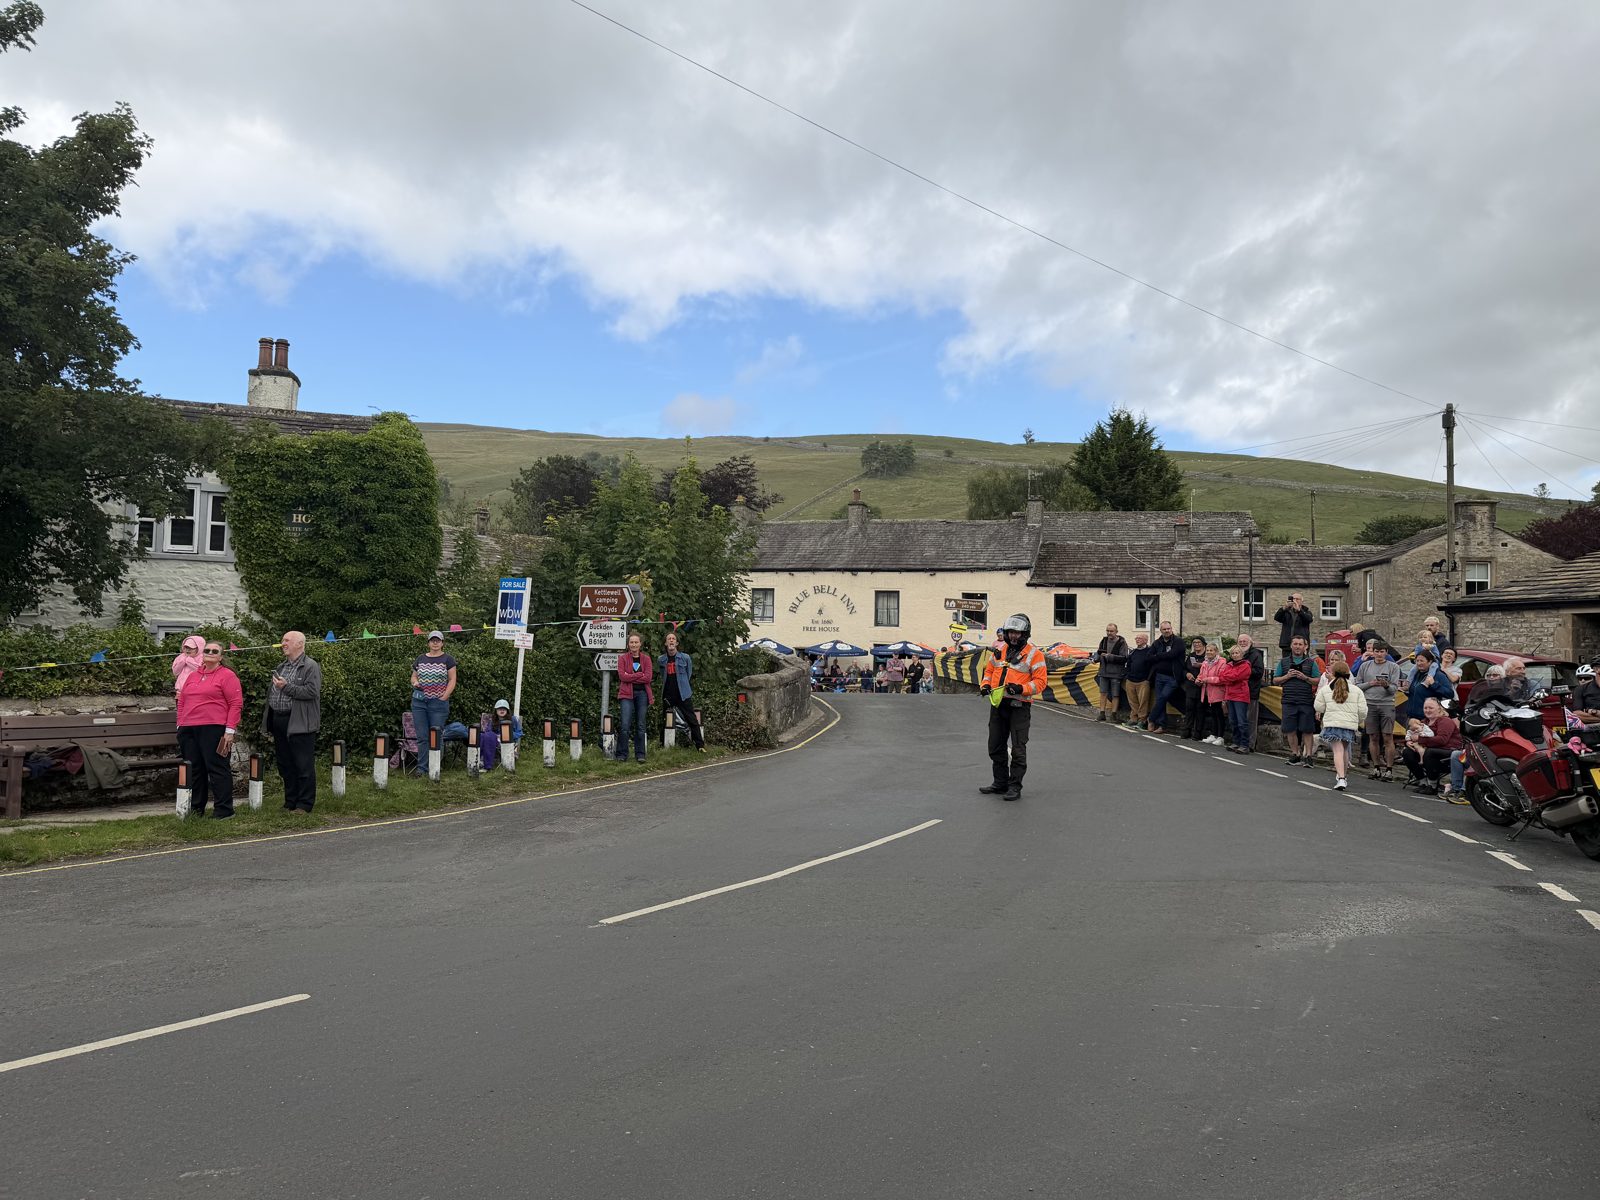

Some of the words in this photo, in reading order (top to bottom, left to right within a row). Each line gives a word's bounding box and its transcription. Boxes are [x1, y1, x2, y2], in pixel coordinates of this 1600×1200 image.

[788, 590, 810, 614] BLUE
[813, 585, 838, 596] BELL
[840, 594, 856, 615] INN
[500, 606, 522, 618] wbw
